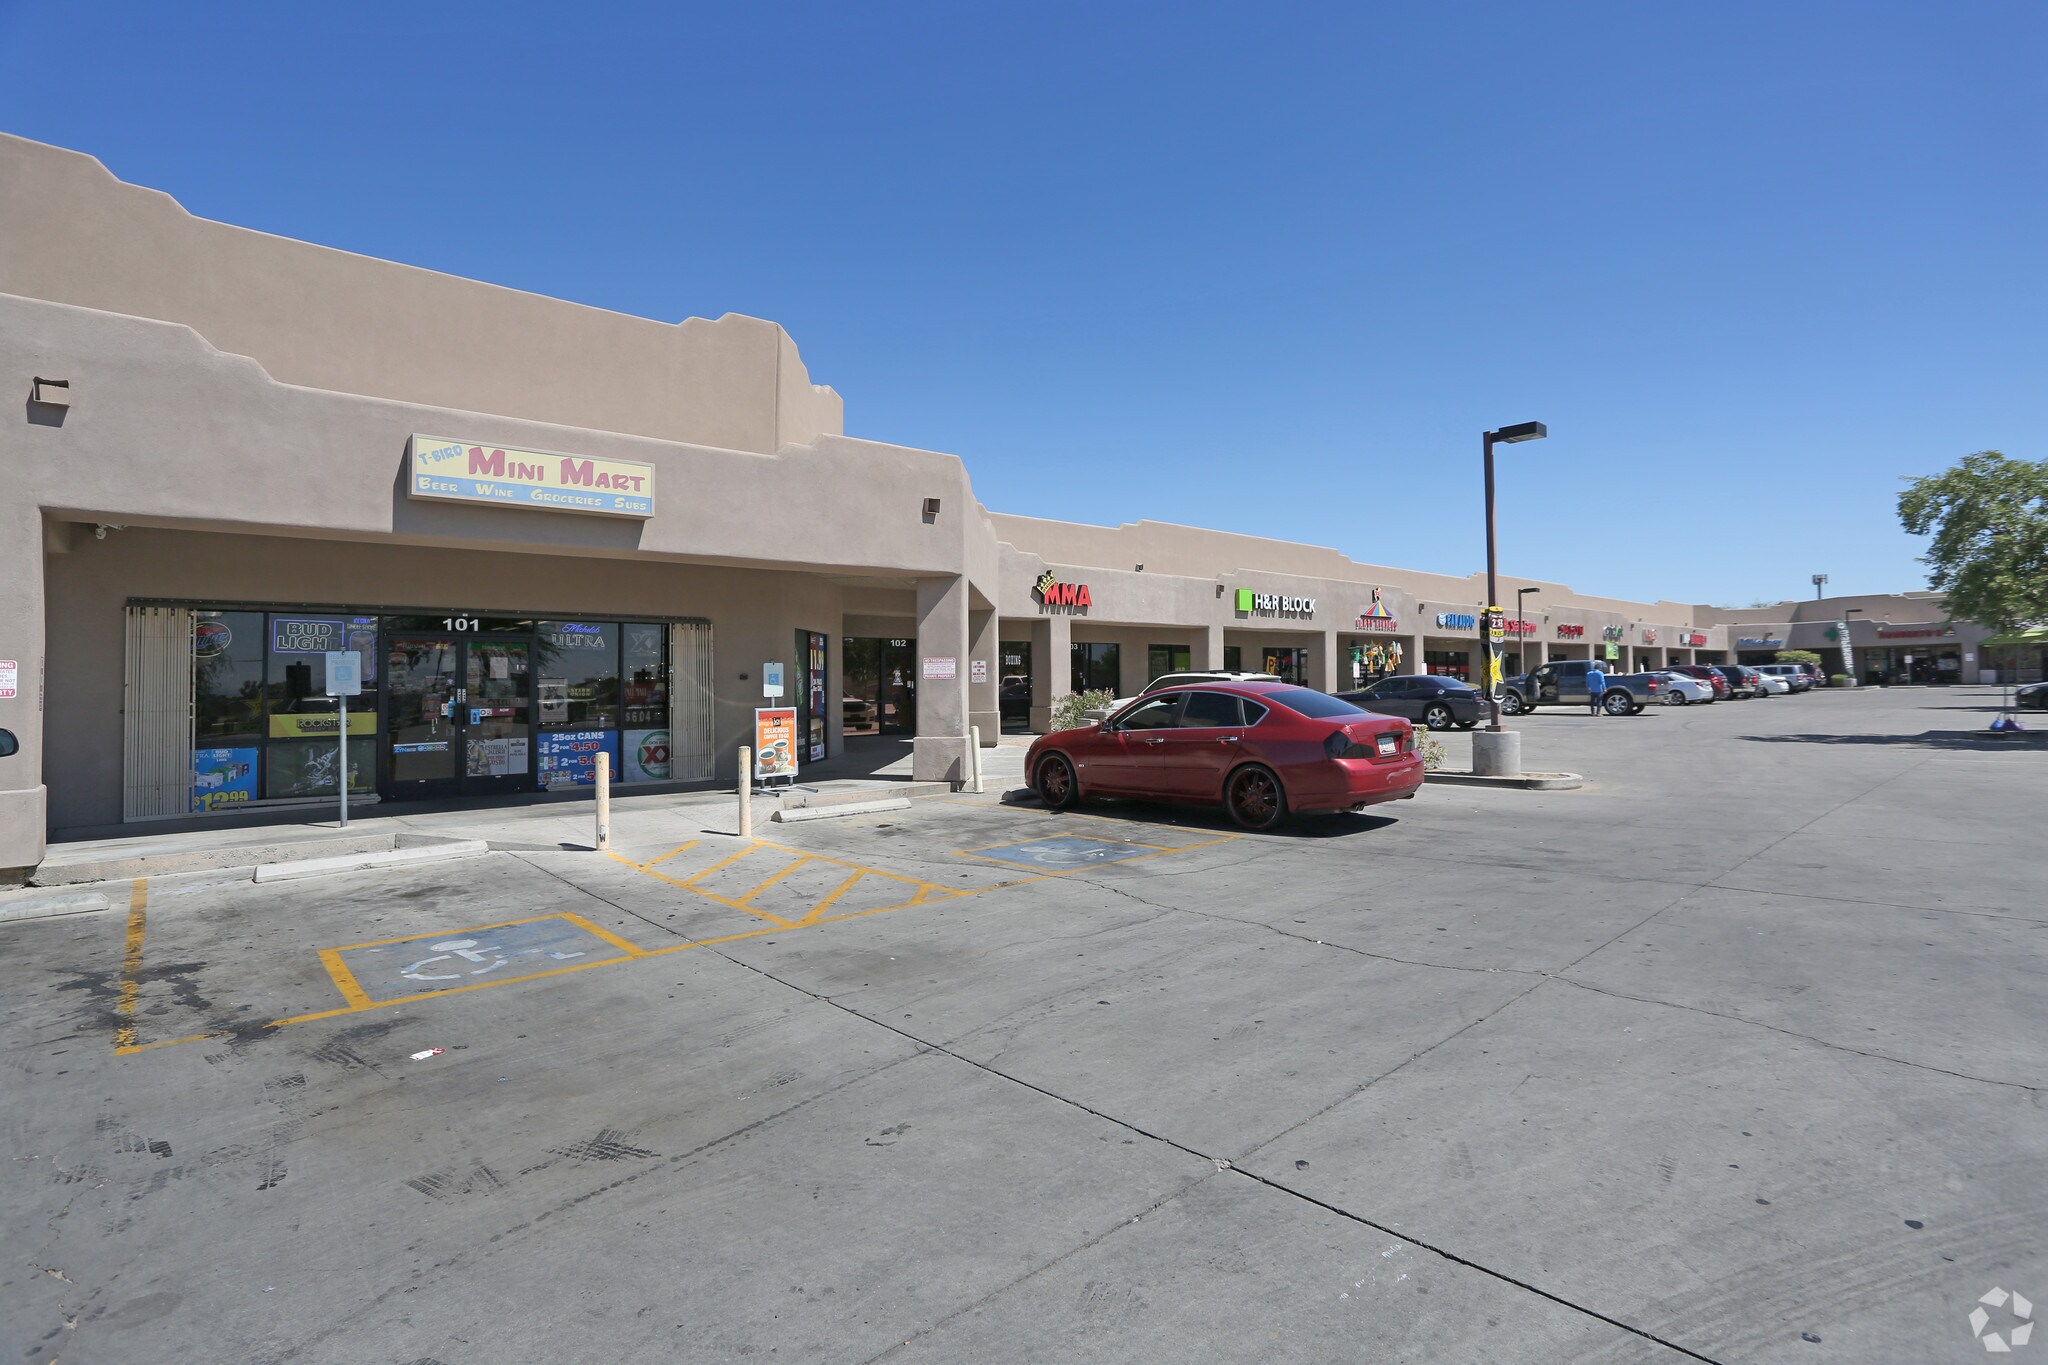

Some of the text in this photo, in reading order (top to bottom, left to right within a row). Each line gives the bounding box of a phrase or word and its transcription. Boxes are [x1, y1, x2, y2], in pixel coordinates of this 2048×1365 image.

[418, 444, 463, 465] T-BIRD
[468, 447, 645, 492] MINI MART
[1044, 582, 1092, 607] MMA
[1255, 593, 1316, 613] H&R BLOCK
[287, 622, 332, 637] BUD
[443, 619, 479, 631] 101
[561, 623, 601, 634] Michelob
[277, 635, 339, 651] LIGHT
[551, 633, 606, 648] ULTRA
[890, 639, 907, 647] 102
[552, 731, 605, 742] 25oz CANS
[551, 743, 560, 753] 2
[561, 758, 569, 767] 2
